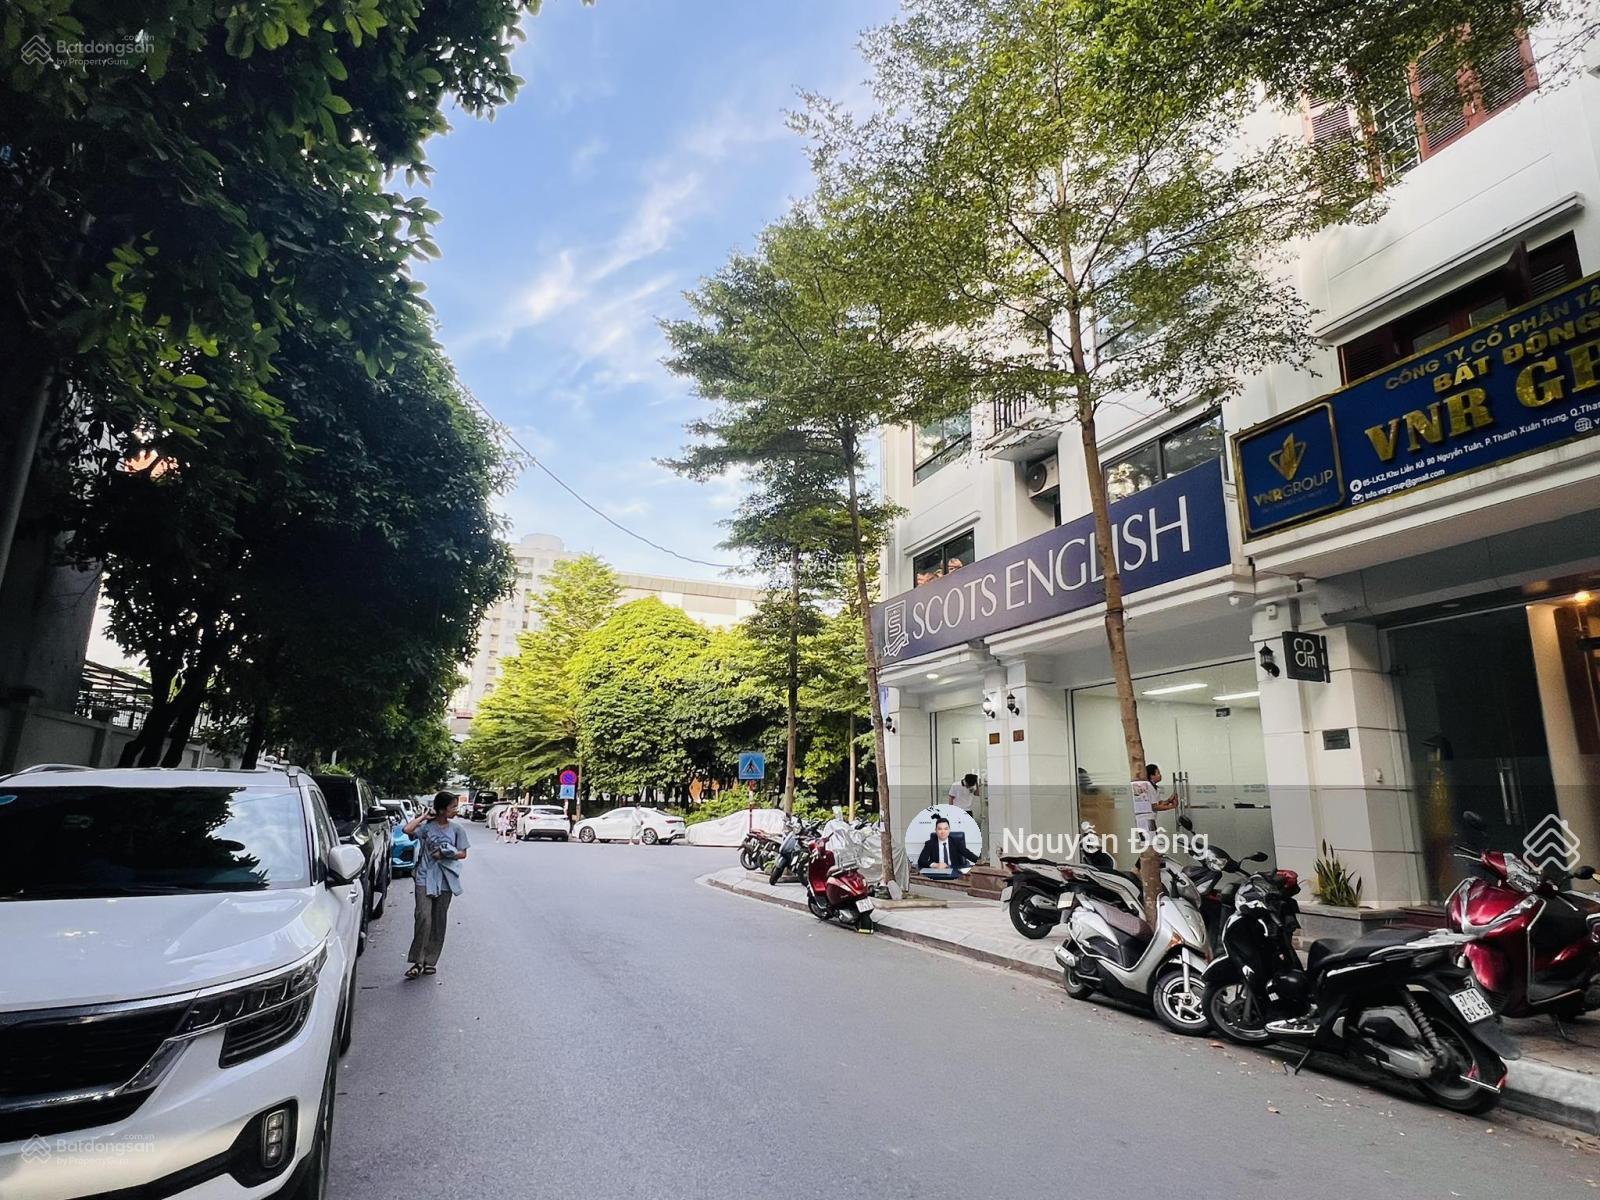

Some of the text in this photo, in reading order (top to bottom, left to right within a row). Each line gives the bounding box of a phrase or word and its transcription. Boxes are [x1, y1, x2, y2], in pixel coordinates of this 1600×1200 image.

[1385, 359, 1440, 390] CÔNG
[1444, 346, 1465, 364] TY
[1471, 325, 1504, 353] CỔ
[1433, 356, 1490, 392] BẤT
[1364, 387, 1494, 462] VNR
[1386, 470, 1399, 479] Khu
[1426, 457, 1435, 466] 90
[1493, 430, 1518, 443] Thanh
[1519, 422, 1541, 434] Xuân
[1252, 469, 1334, 507] VNRGROUP
[912, 495, 1191, 640] SCOTS ENGLISH
